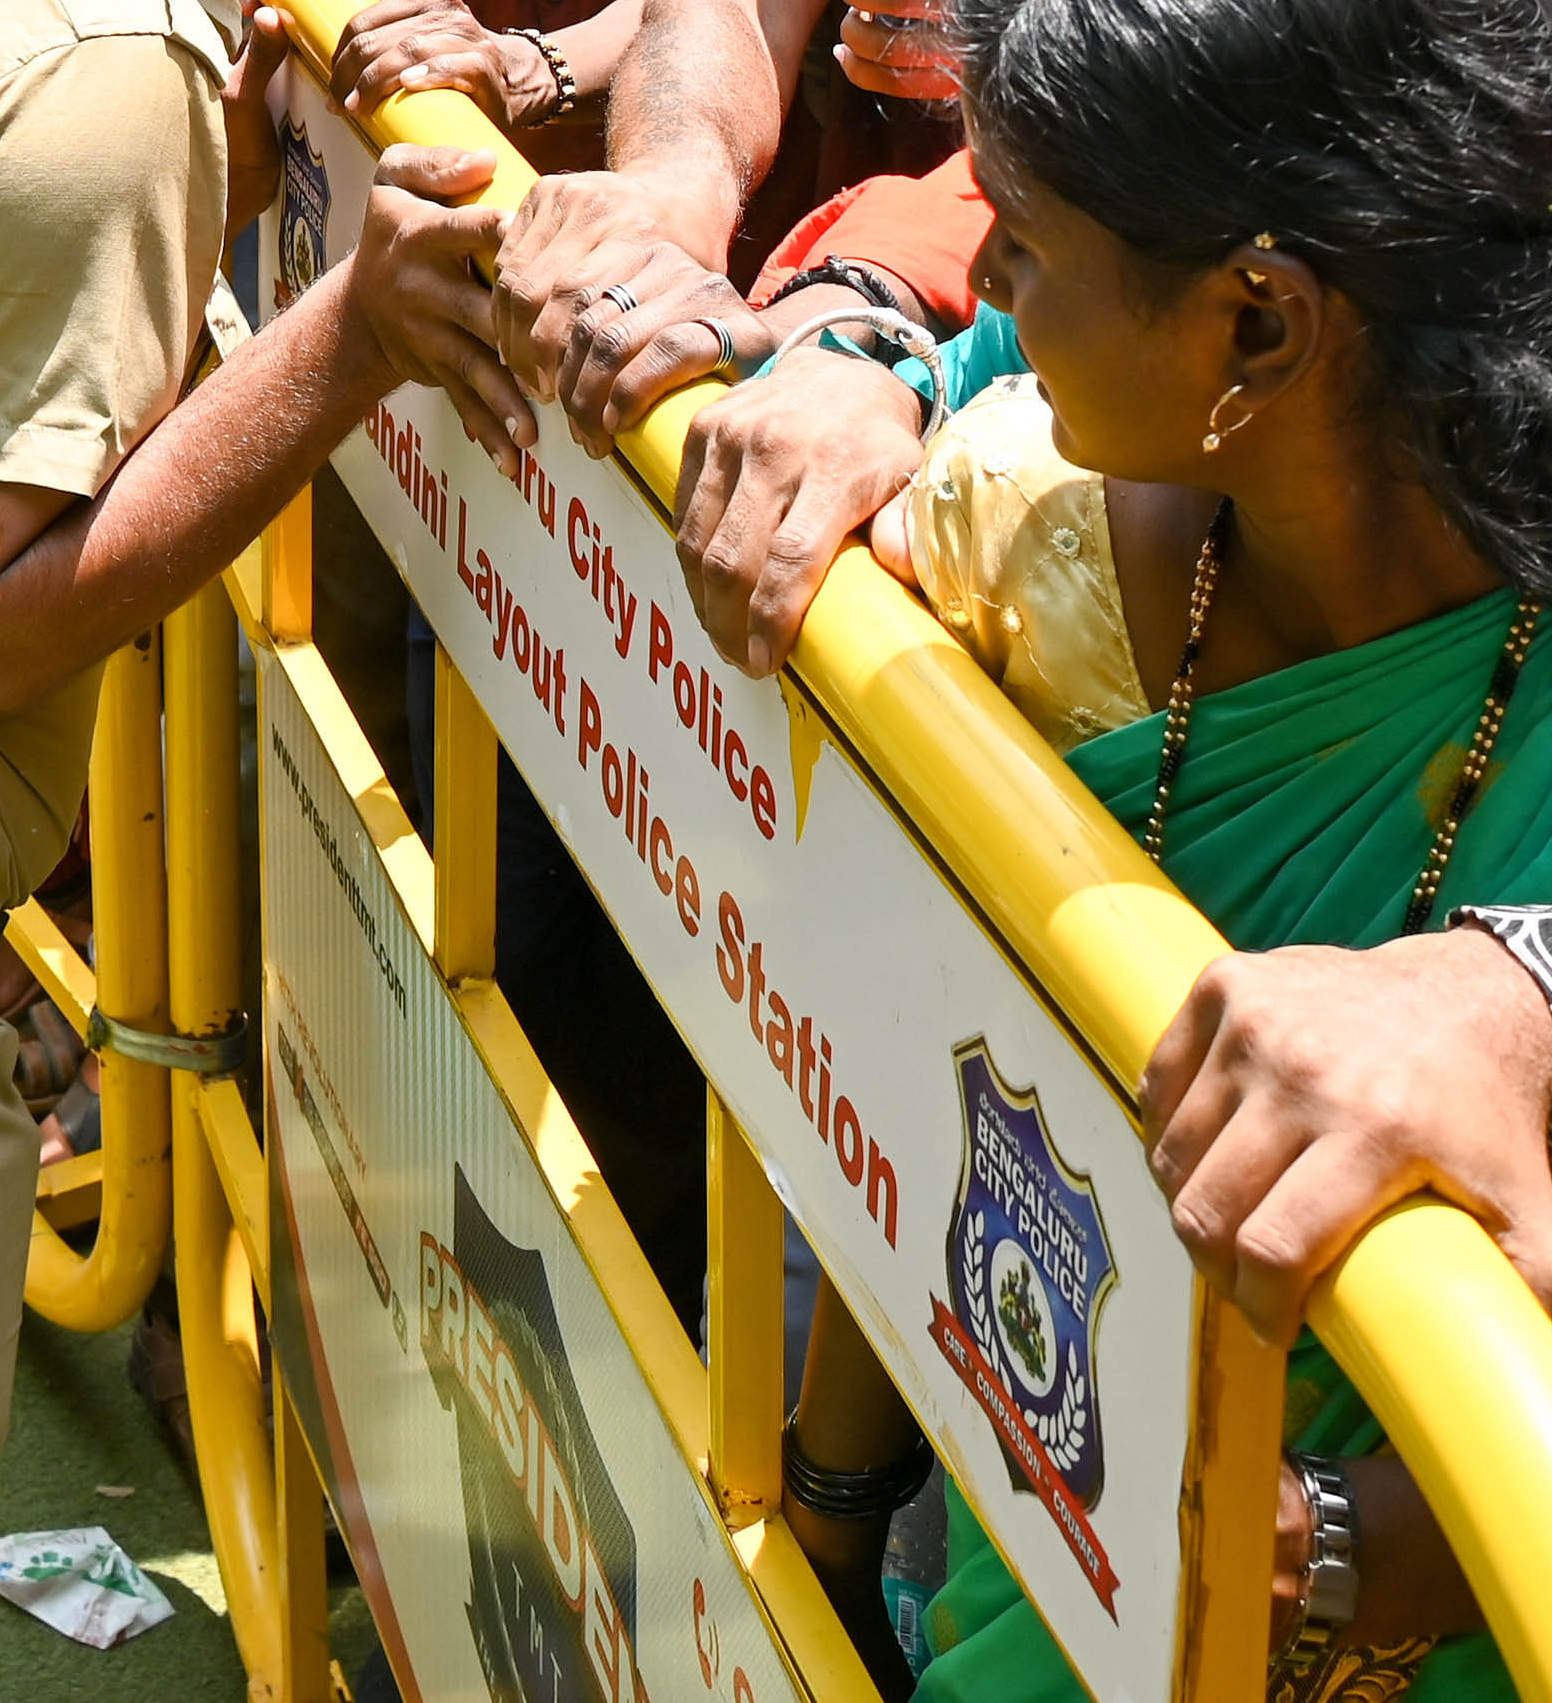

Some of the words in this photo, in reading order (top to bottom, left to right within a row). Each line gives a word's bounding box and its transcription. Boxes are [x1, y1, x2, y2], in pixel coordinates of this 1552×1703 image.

[567, 496, 638, 660] City
[649, 600, 777, 841] Police
[272, 722, 407, 1019] www.presidenttmt.com
[365, 400, 449, 553] andini
[456, 495, 567, 738] Layout
[577, 677, 701, 938] Police
[715, 890, 898, 1253] Station
[974, 1146, 1015, 1219] CITY
[1017, 1205, 1086, 1322] POLICE
[975, 1110, 1089, 1283] BENGALURU
[943, 1326, 968, 1365] CARE
[975, 1370, 1042, 1481] COMPASSION
[1052, 1488, 1101, 1578] COURAGE
